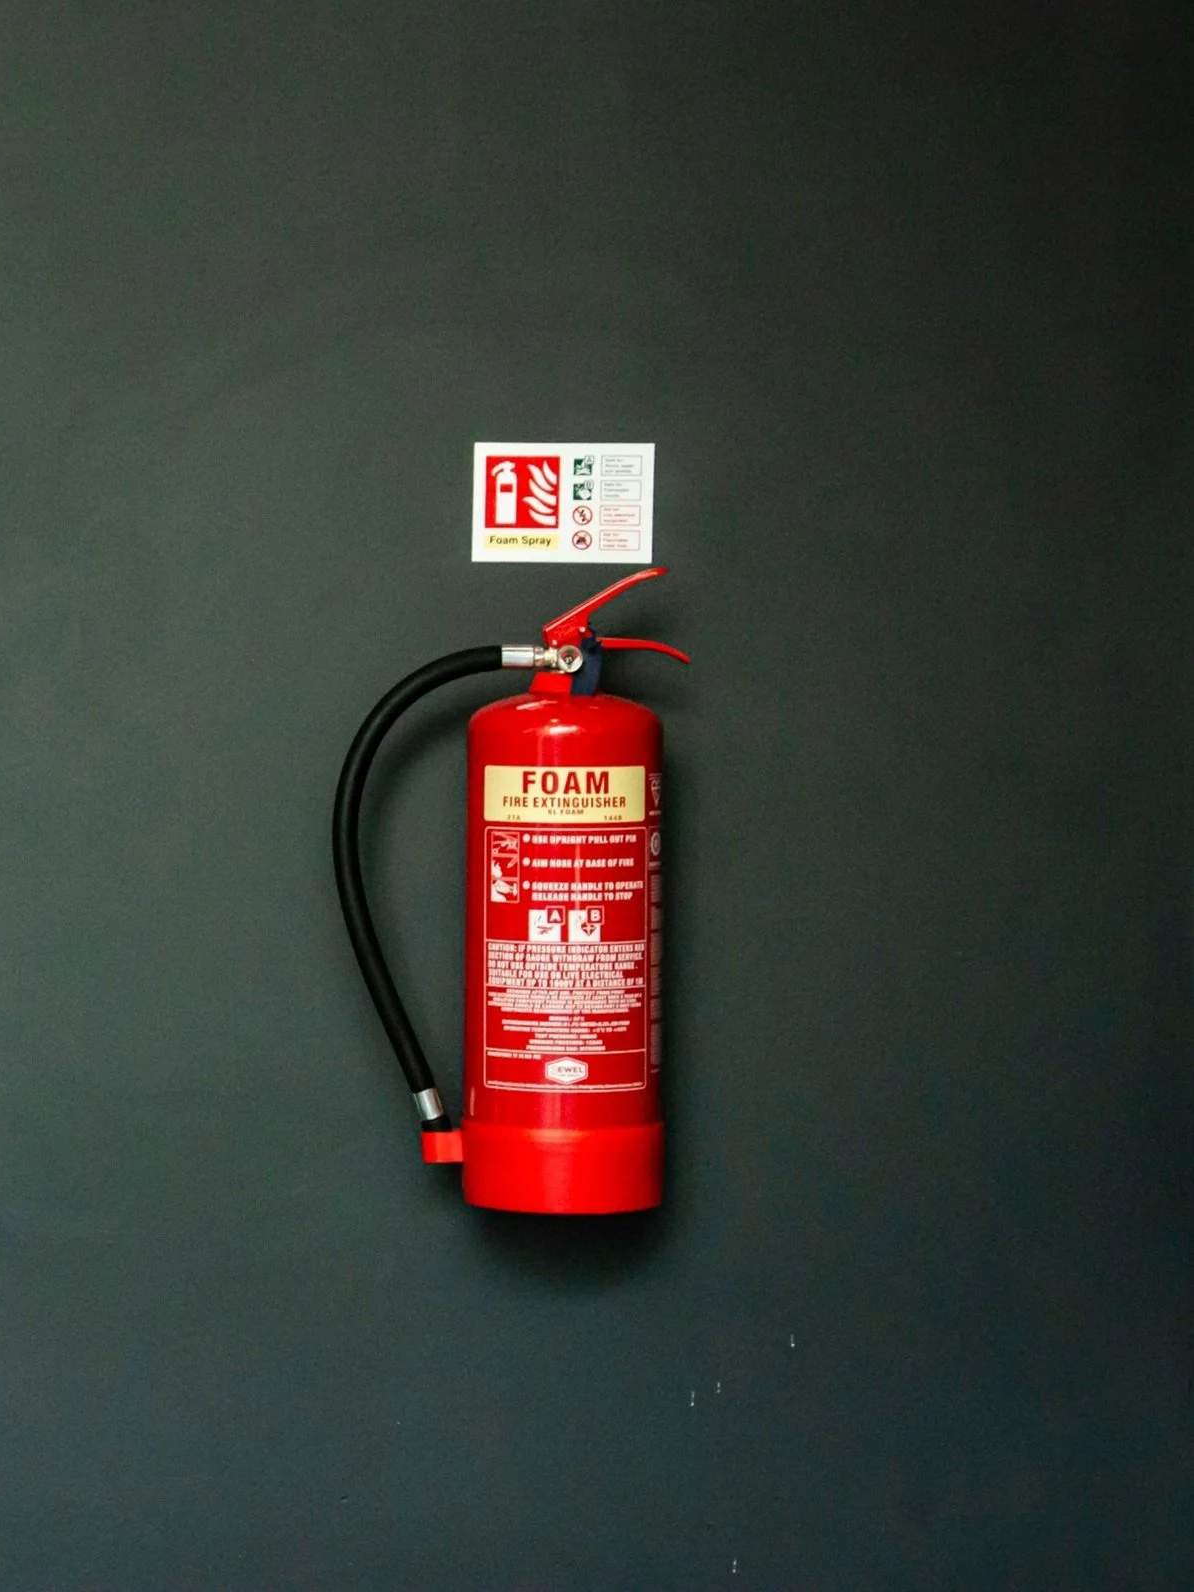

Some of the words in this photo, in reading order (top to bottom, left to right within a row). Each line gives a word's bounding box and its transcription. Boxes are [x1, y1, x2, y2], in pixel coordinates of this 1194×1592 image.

[489, 535, 518, 545] Foam
[521, 535, 552, 547] Spray
[522, 770, 610, 795] FOAM
[502, 796, 529, 808] FIRE
[532, 796, 626, 808] EXTINGUISHER
[532, 835, 548, 844] USE
[549, 835, 587, 844] UPRIGHT
[587, 835, 608, 844] PULL
[609, 834, 624, 844] OUT
[625, 834, 637, 843] PIN
[531, 858, 548, 868] AIM
[573, 859, 585, 868] AT
[585, 859, 606, 868] BASE
[607, 858, 618, 867] OF
[618, 858, 634, 867] FIRE
[532, 881, 569, 891] SQUEEZE
[570, 882, 603, 891] HANDLE
[604, 882, 614, 891] TO
[615, 881, 644, 890] OPERATE
[531, 892, 569, 901] RELEASE
[570, 892, 603, 901] HANDLE
[604, 892, 614, 901] TO
[615, 892, 633, 901] STOP
[550, 910, 561, 921] A
[590, 910, 600, 921] B
[526, 945, 566, 953] PRESSURE
[567, 945, 608, 953] INDICATOR
[609, 944, 633, 953] ENTERS
[552, 954, 595, 962] WITHDRAW
[595, 953, 617, 962] FROM
[525, 962, 558, 971] OUTSIDE
[558, 962, 613, 971] TEMPERATURE
[581, 970, 624, 979] ELECTRICAL
[592, 978, 626, 987] DISTANCE
